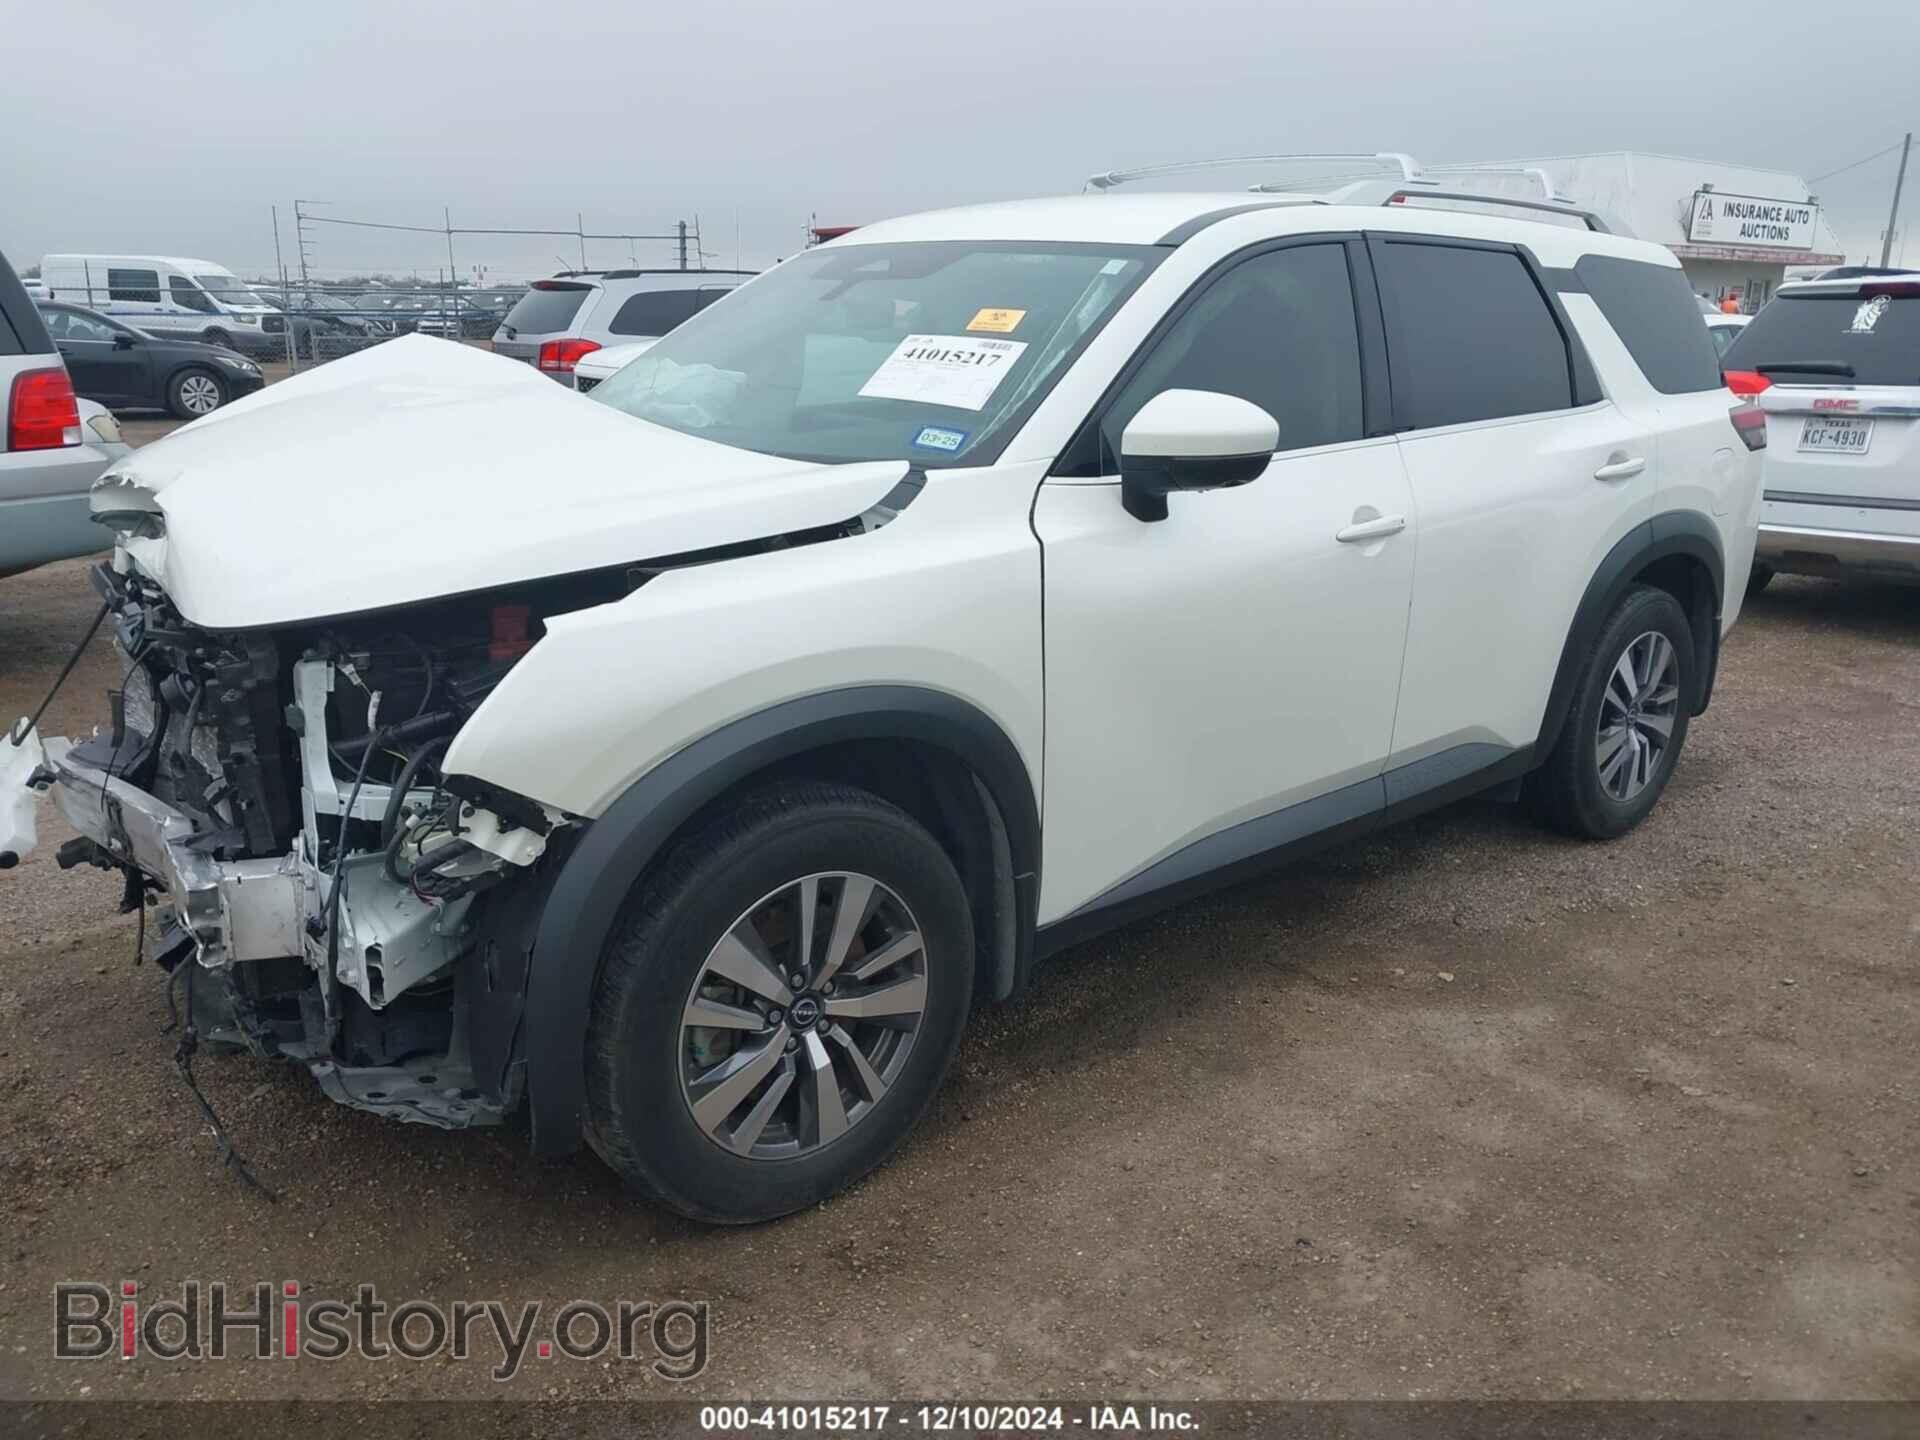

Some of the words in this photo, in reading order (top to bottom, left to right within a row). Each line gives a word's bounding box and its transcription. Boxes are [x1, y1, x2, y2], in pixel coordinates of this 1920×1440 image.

[1723, 202, 1783, 222] INSURANCE
[1784, 208, 1810, 225] AUTO
[1739, 223, 1791, 241] AUCTIONS
[903, 347, 1003, 367] 41015217
[1813, 398, 1858, 410] GMC
